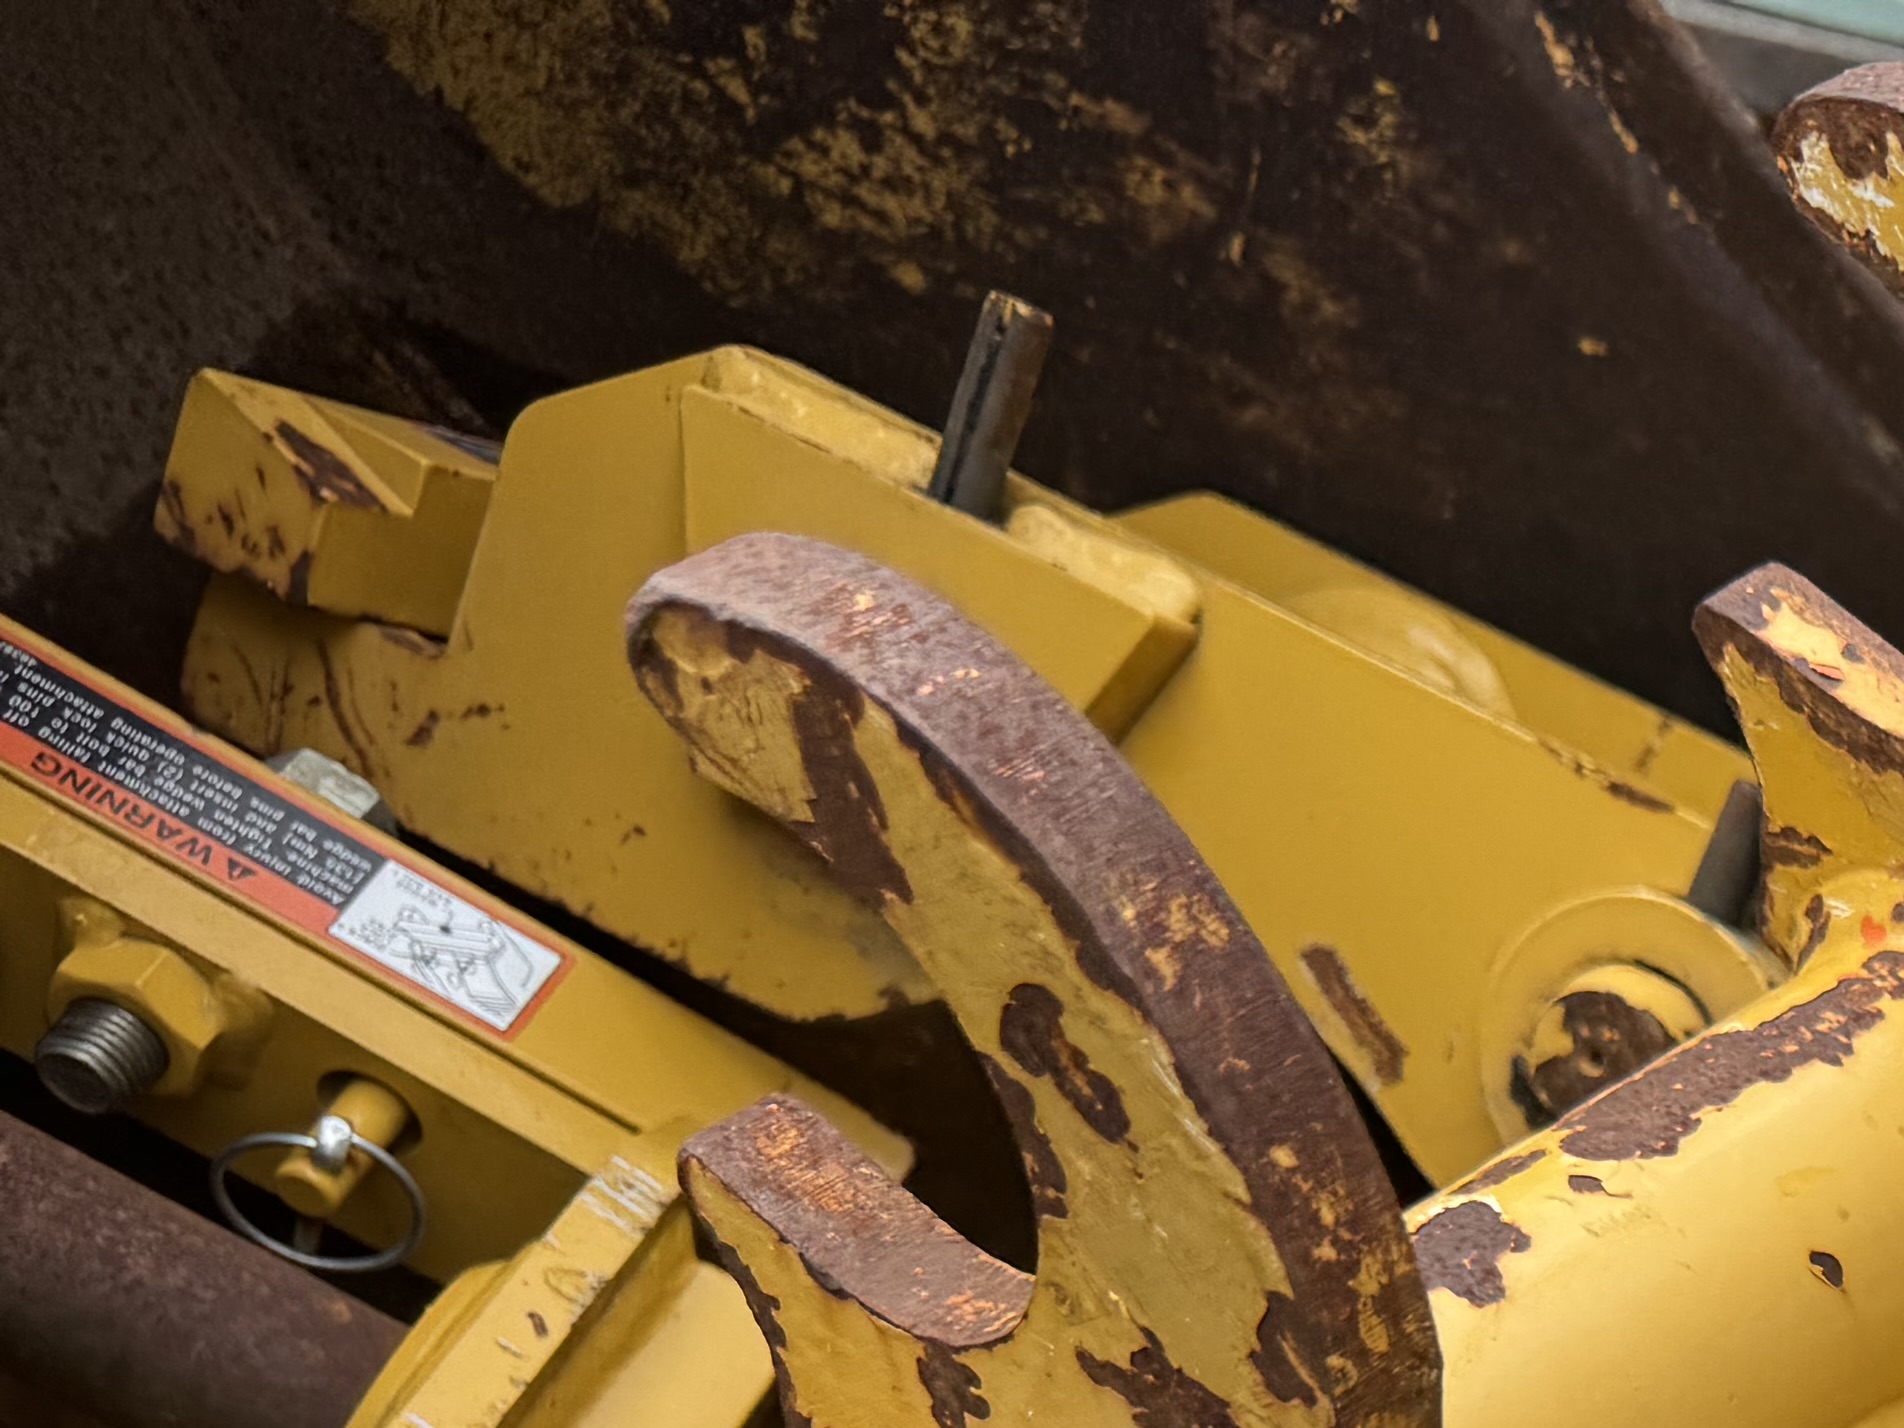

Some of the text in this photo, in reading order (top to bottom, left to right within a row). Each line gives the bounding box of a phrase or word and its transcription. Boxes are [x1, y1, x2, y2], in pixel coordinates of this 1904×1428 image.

[7, 693, 40, 718] 100
[15, 680, 55, 710] pins
[1, 705, 31, 729] off
[49, 716, 69, 734] to
[60, 706, 98, 734] lock
[36, 724, 92, 763] falling
[75, 730, 110, 757] bolt
[103, 729, 151, 763] quick
[108, 715, 187, 767] operating
[116, 753, 146, 777] bar
[155, 757, 184, 782] (2)
[96, 758, 192, 819] attachment
[152, 773, 207, 811] wedge
[188, 778, 239, 814] insert
[189, 762, 244, 800] before
[28, 748, 217, 865] WARNING
[247, 794, 285, 823] pins
[195, 816, 237, 846] from
[243, 809, 277, 836] and
[288, 819, 318, 842] bar
[241, 840, 293, 877] injury
[320, 836, 374, 874] wedge
[294, 872, 346, 907] Avoid
